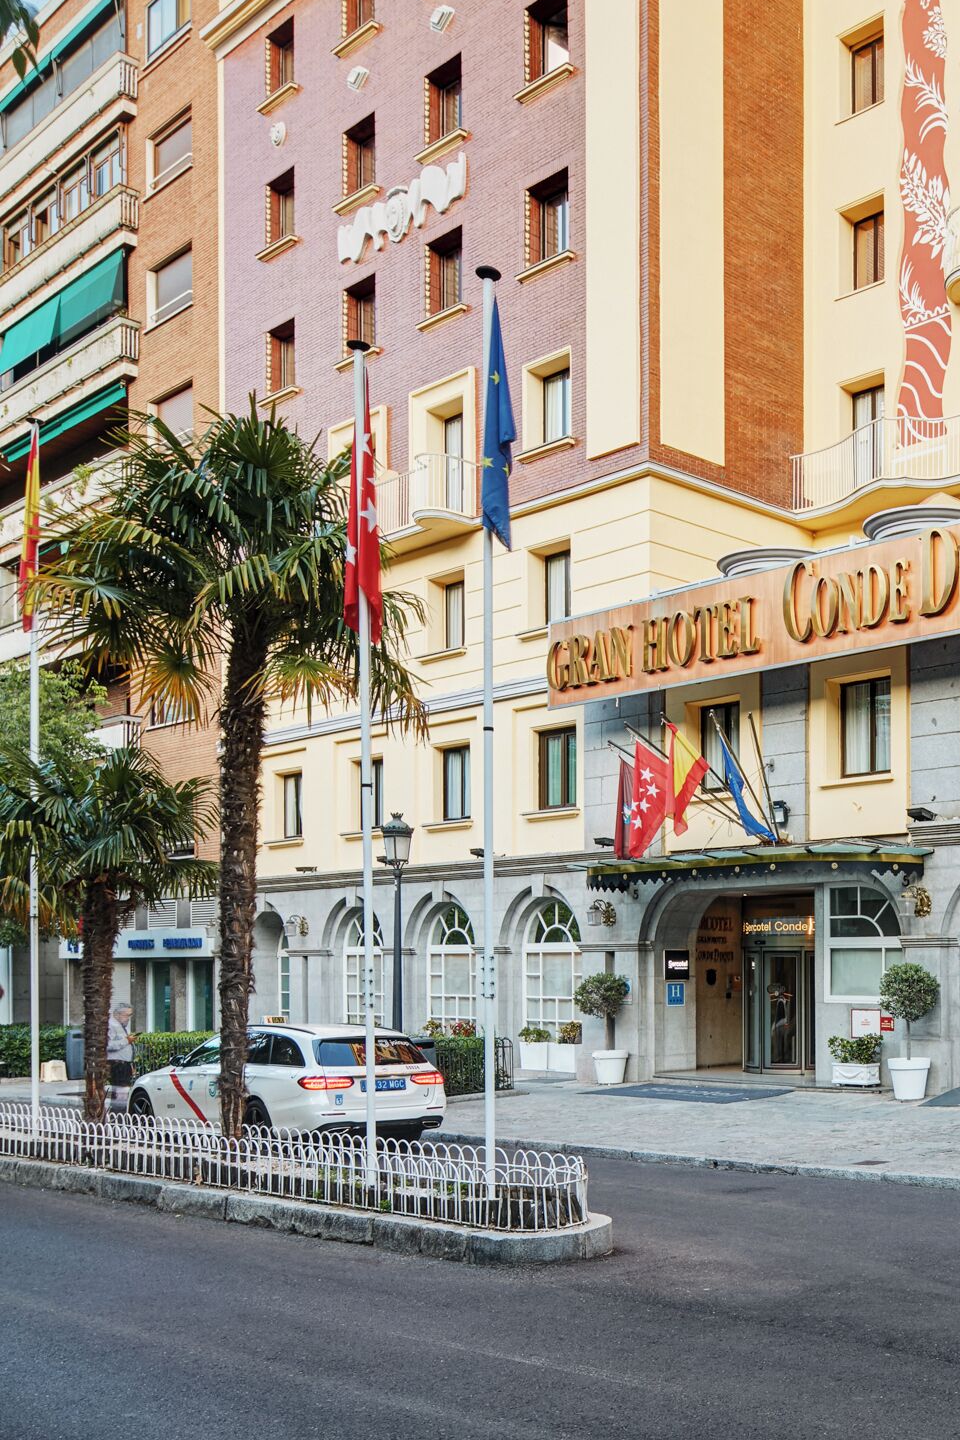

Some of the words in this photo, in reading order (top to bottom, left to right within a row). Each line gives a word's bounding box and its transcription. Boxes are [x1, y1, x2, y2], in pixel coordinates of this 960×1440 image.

[547, 624, 634, 691] GRAN
[641, 595, 761, 674] HOTEL
[782, 557, 912, 643] CONDE
[633, 889, 639, 900] 5
[745, 921, 772, 934] Sercotel
[774, 921, 808, 931] Conde
[672, 985, 680, 997] H
[389, 1079, 405, 1089] MGC
